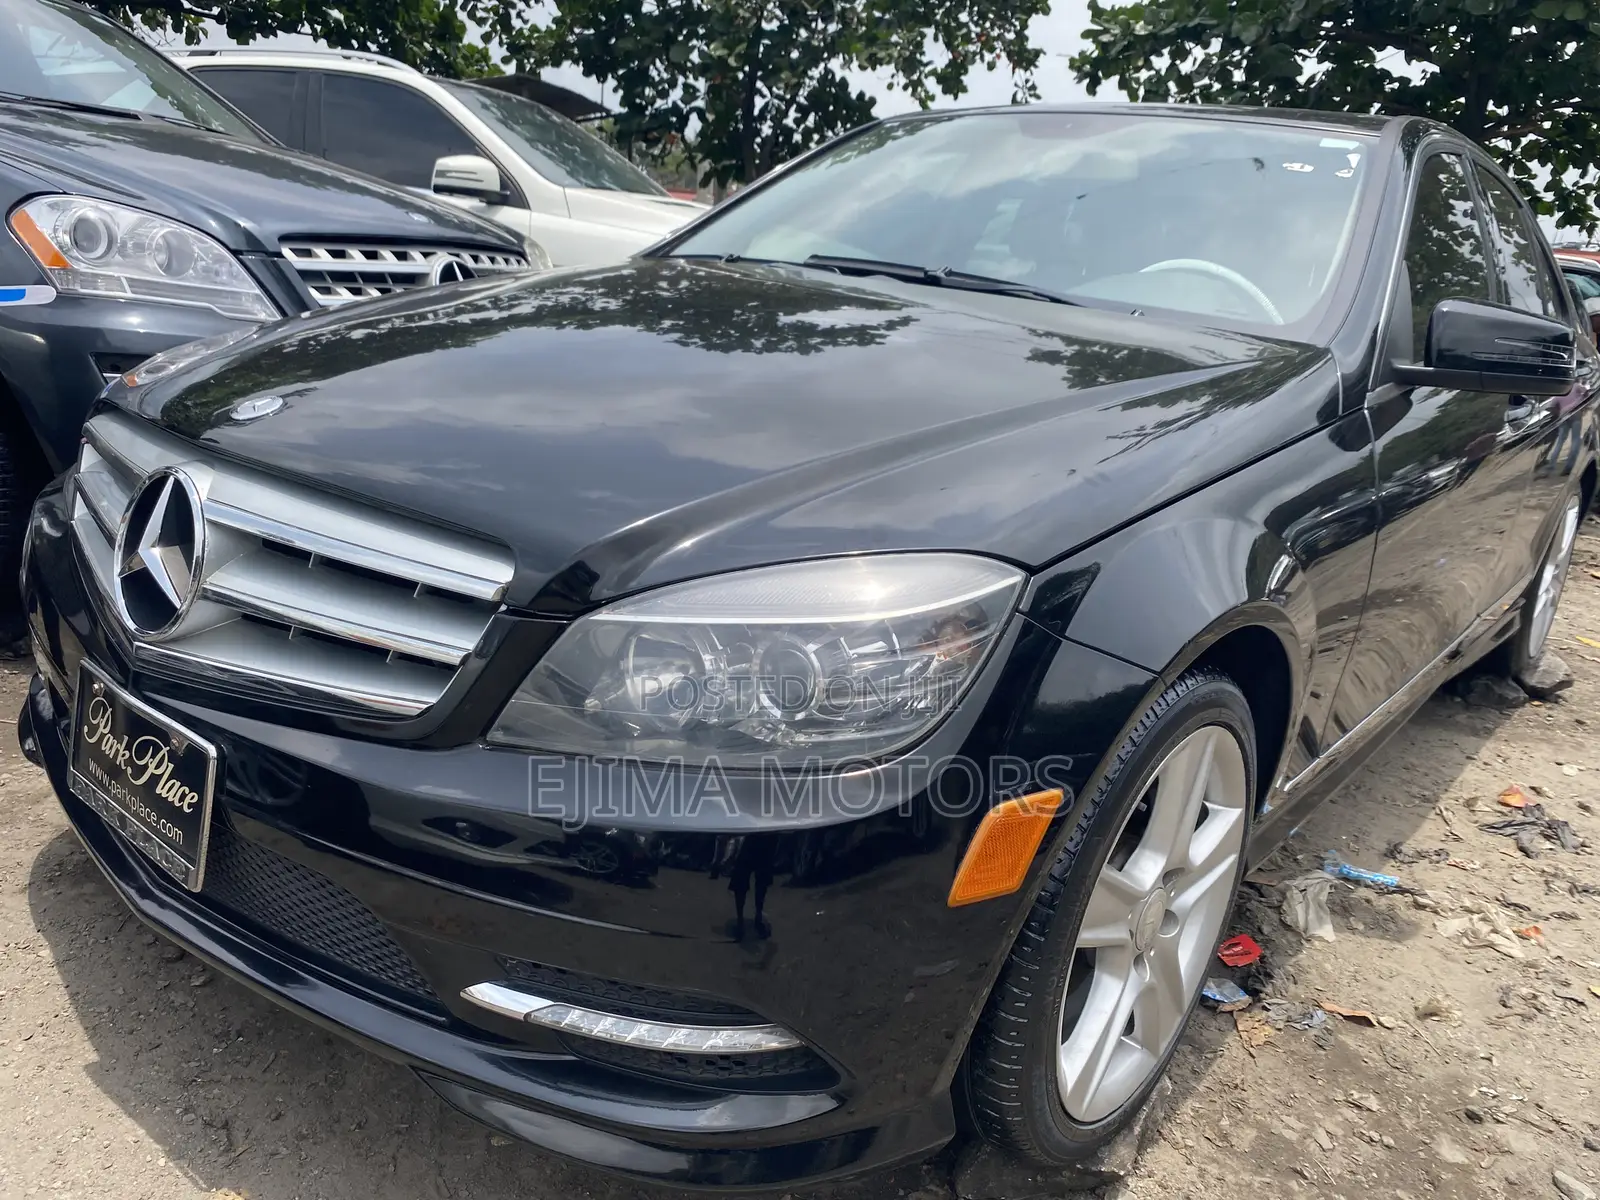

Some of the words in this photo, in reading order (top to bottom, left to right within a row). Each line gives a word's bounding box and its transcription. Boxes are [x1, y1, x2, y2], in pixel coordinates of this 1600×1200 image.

[84, 696, 130, 770] Park
[127, 735, 199, 814] Place
[88, 757, 184, 846] www.parkplace.com
